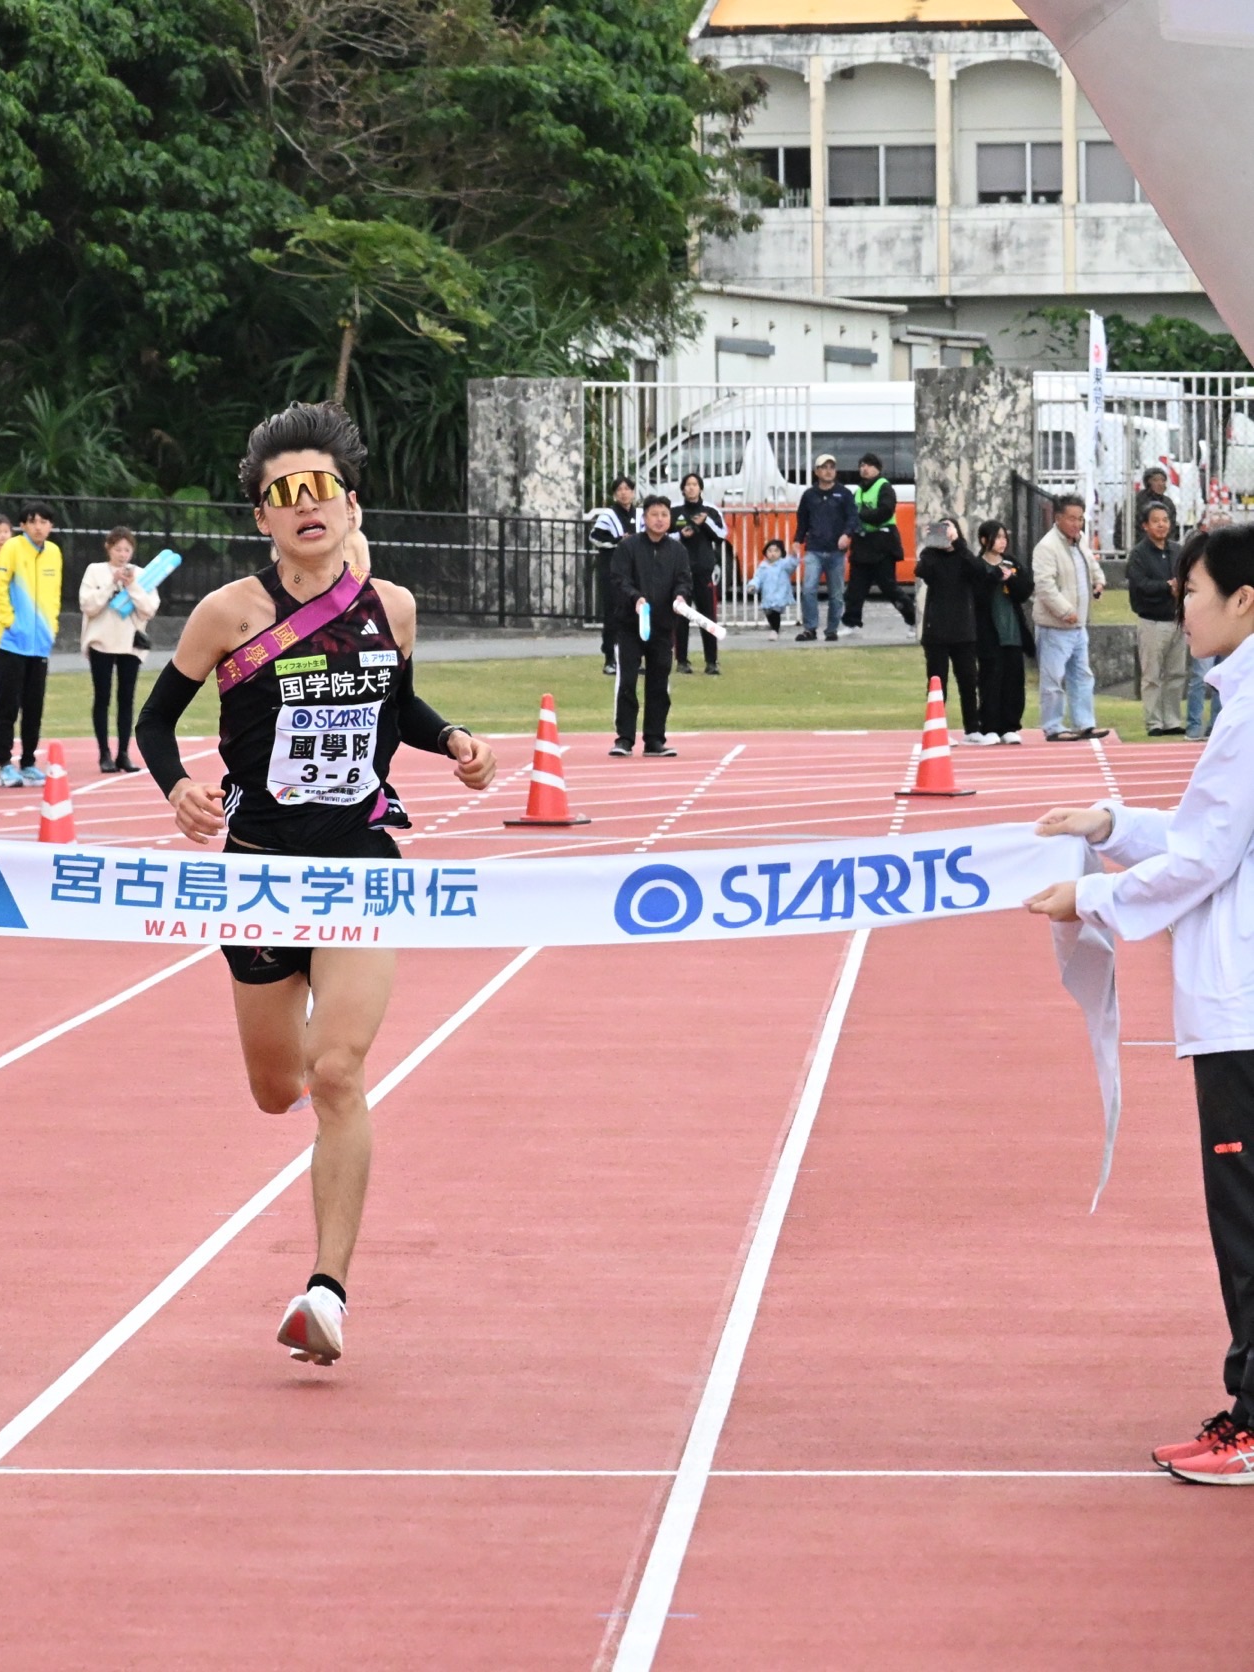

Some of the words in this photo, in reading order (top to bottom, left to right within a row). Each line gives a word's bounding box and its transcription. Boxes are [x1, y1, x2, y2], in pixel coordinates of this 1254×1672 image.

[276, 659, 326, 672] ライフネット生命
[371, 653, 397, 663] アサガミ
[279, 668, 392, 703] 国学院大学
[314, 706, 377, 729] STARTS
[289, 732, 371, 762] 國學院
[50, 853, 479, 918] 宮古島大学駅伝
[712, 845, 991, 931] STARTS
[144, 919, 381, 943] WAIDO-ZUMI
